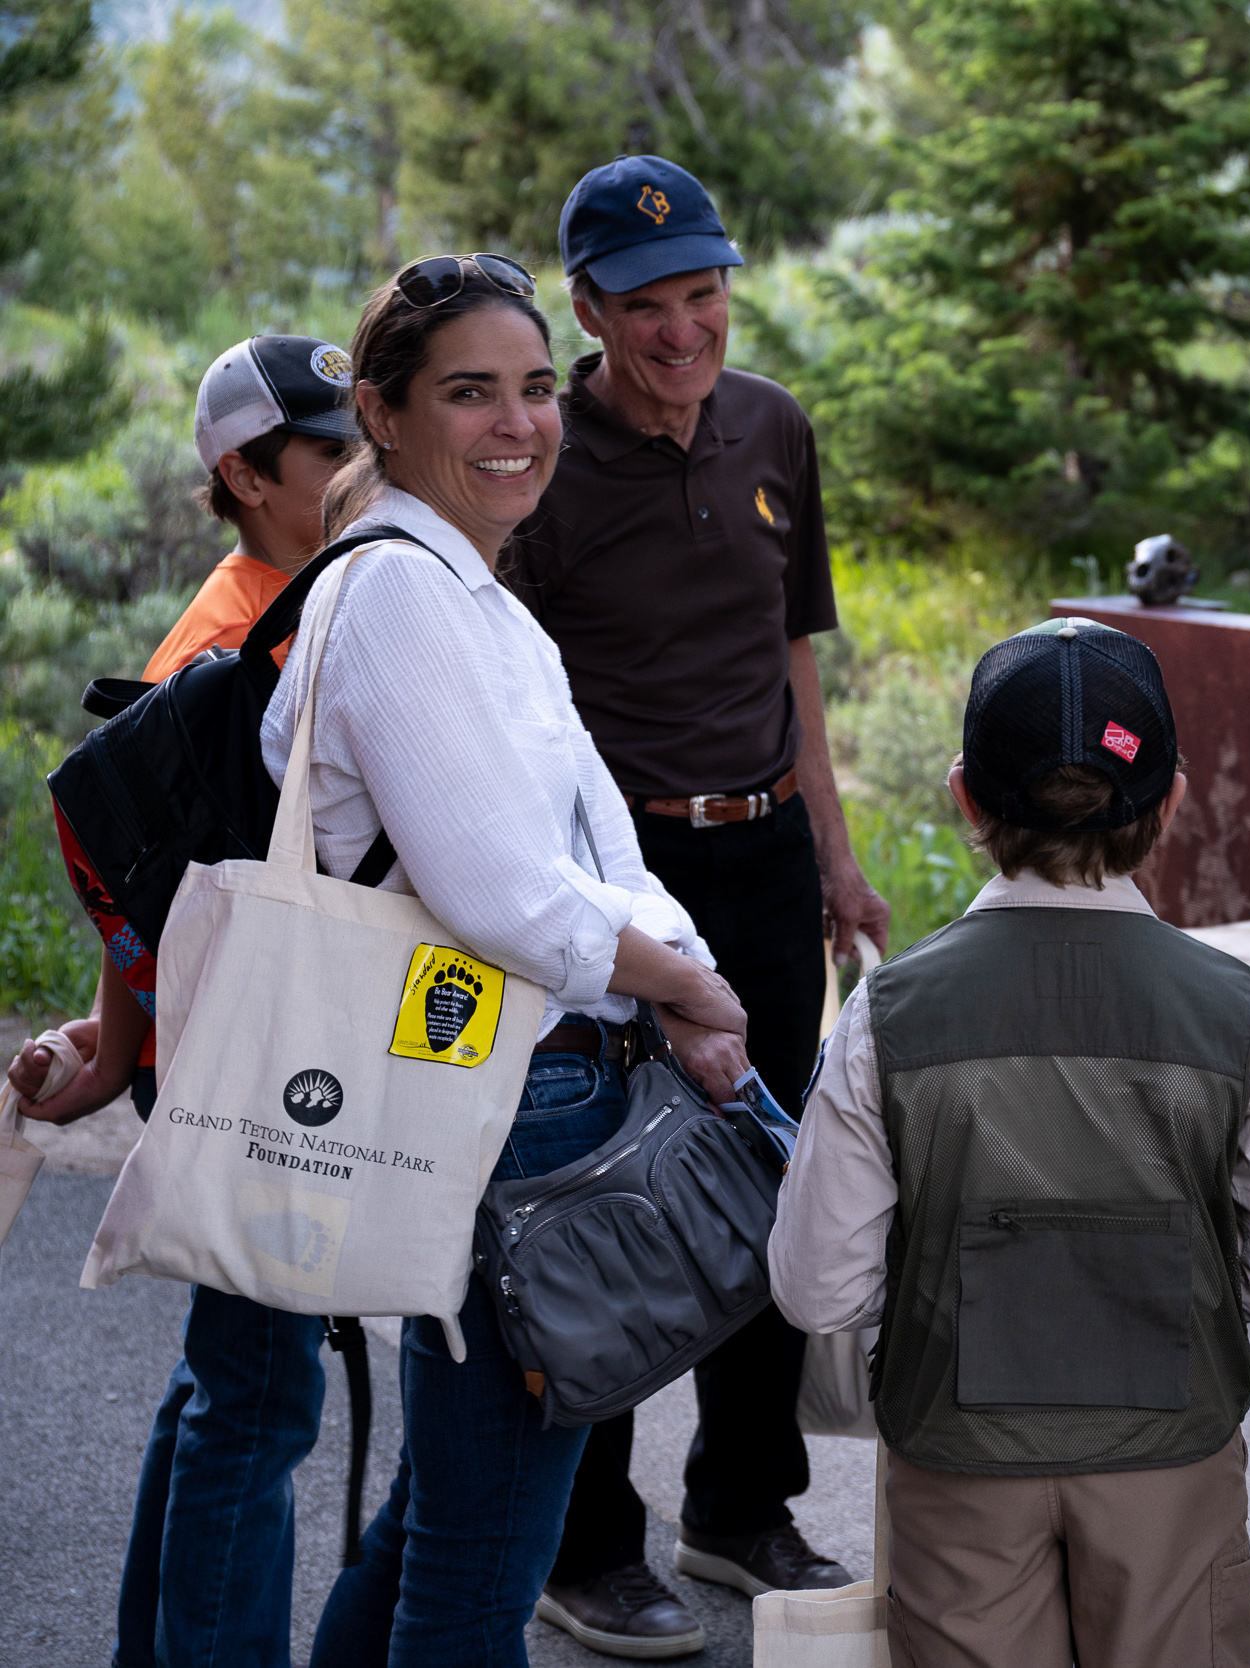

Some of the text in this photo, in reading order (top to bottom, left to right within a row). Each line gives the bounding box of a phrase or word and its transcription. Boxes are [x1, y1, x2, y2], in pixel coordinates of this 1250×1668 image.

[410, 952, 435, 995] Standard
[434, 986, 440, 995] Be
[441, 987, 452, 996] Bear
[169, 1107, 436, 1174] GRAND TETON NATIONAL PARK
[246, 1141, 353, 1180] FOUNDATION
